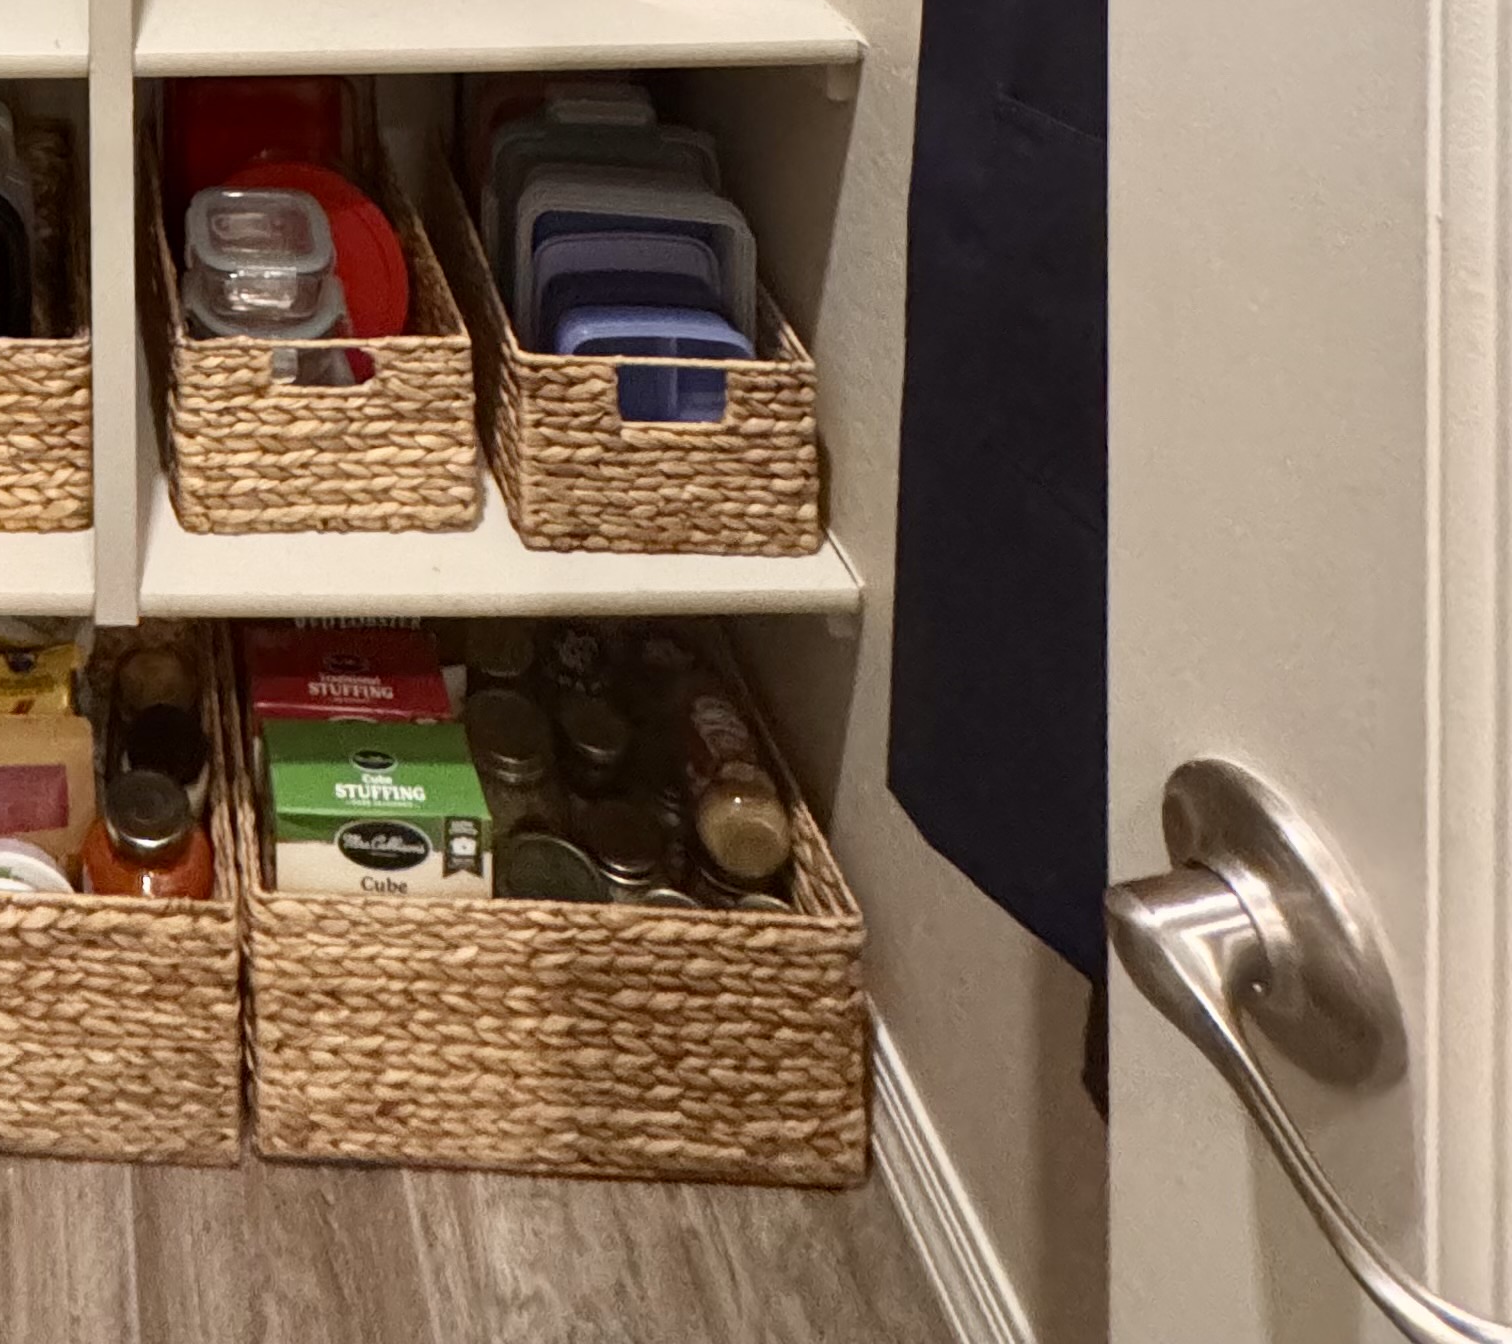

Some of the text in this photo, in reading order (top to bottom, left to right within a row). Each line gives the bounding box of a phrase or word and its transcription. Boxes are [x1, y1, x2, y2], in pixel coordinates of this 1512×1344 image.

[307, 680, 394, 700] STUFFING
[361, 773, 393, 785] Cube
[335, 782, 427, 802] STUFFING
[360, 875, 408, 894] Cube
